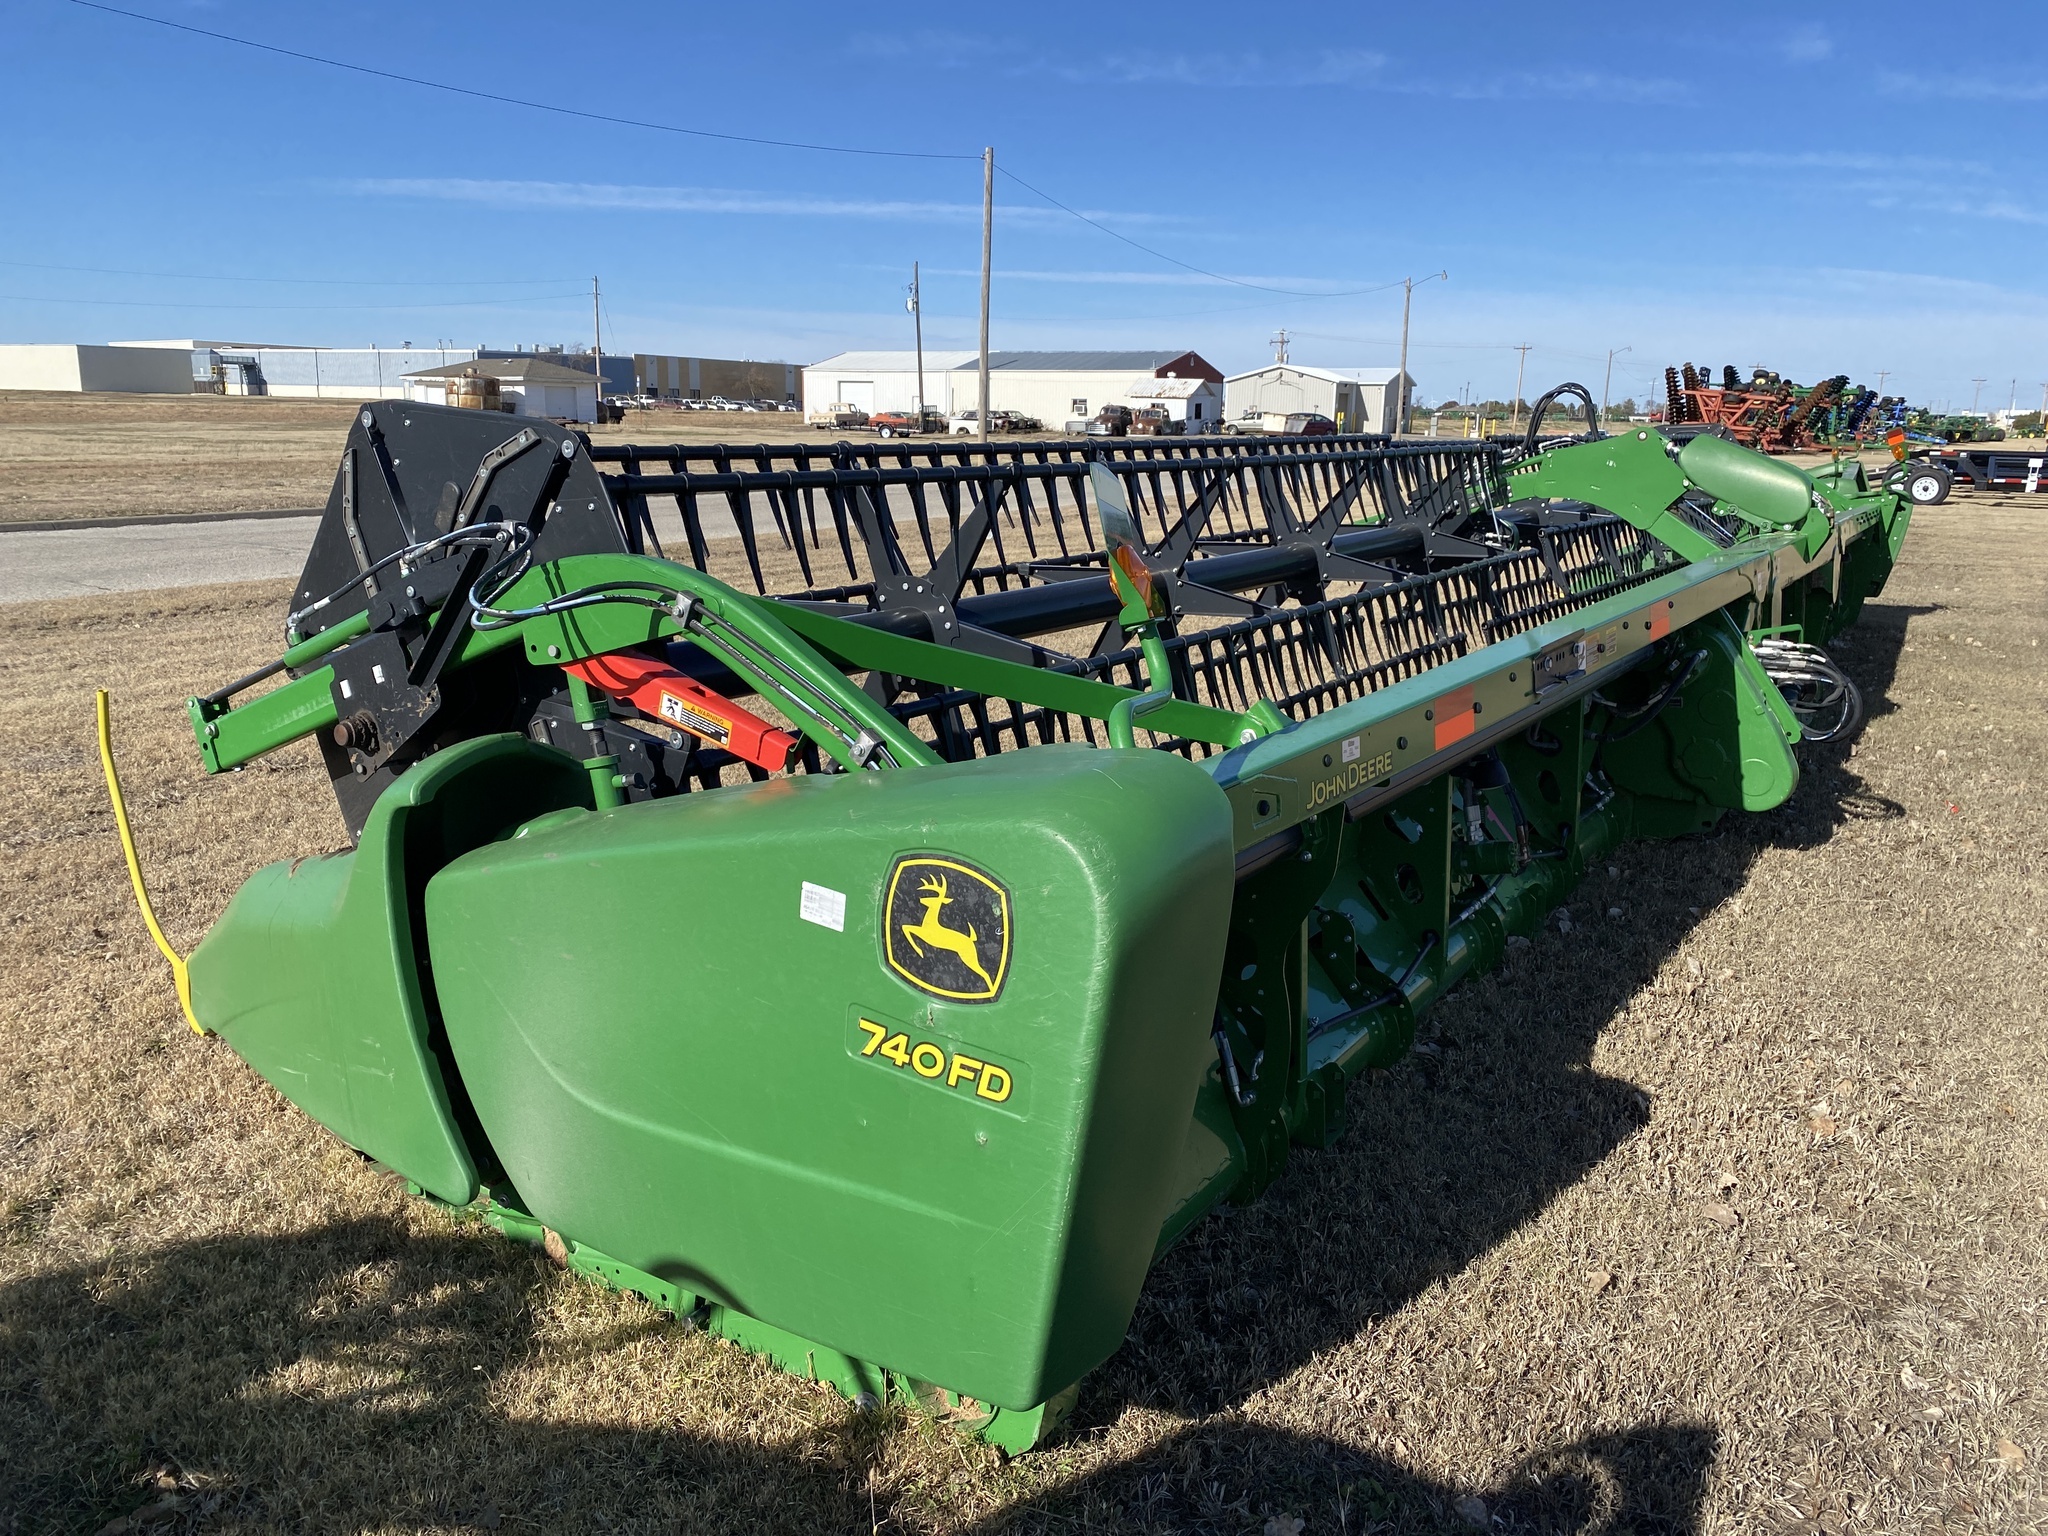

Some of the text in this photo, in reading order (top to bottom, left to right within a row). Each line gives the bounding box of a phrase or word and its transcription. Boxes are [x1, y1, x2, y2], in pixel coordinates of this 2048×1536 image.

[697, 708, 724, 725] WARNING
[1306, 750, 1393, 810] JOHN DEERE
[858, 1016, 1014, 1103] 740FD
